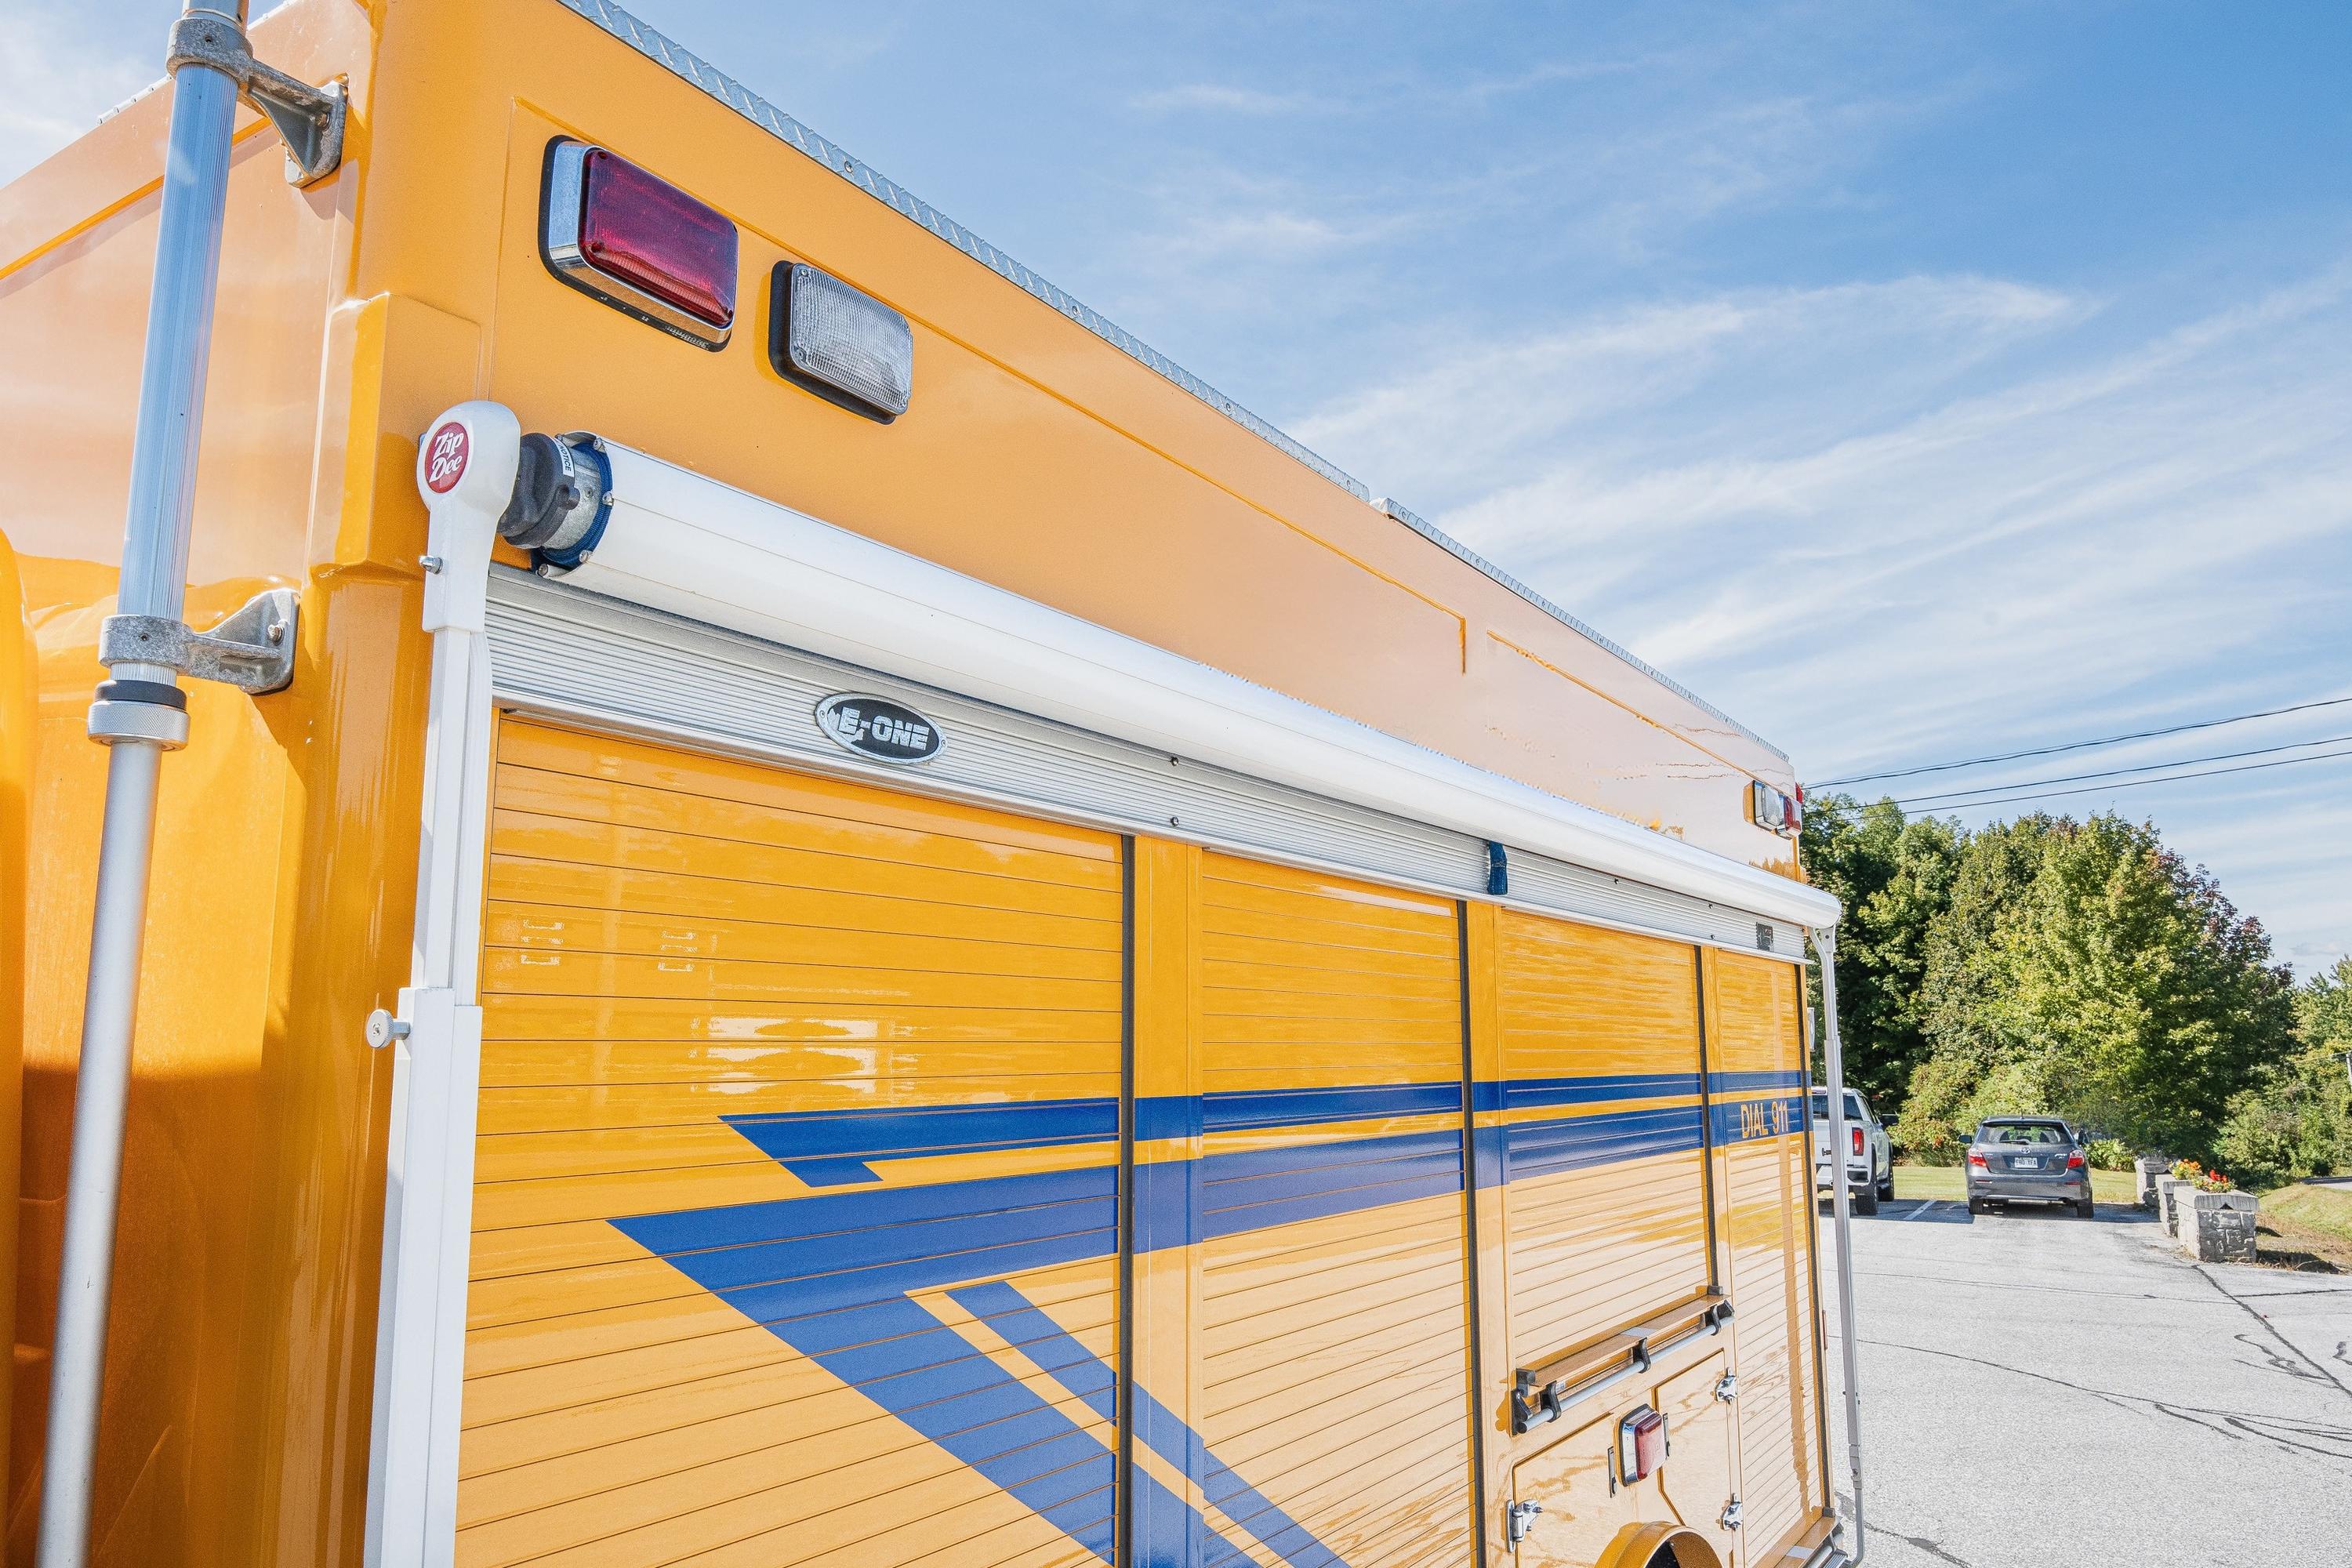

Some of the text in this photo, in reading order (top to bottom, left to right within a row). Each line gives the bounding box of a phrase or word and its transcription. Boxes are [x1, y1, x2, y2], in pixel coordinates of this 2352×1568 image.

[432, 431, 465, 461] Zip
[558, 444, 572, 472] NOTICE
[429, 455, 463, 483] Dee
[837, 706, 930, 751] E-ONE
[1740, 1100, 1789, 1138] DIAL 911
